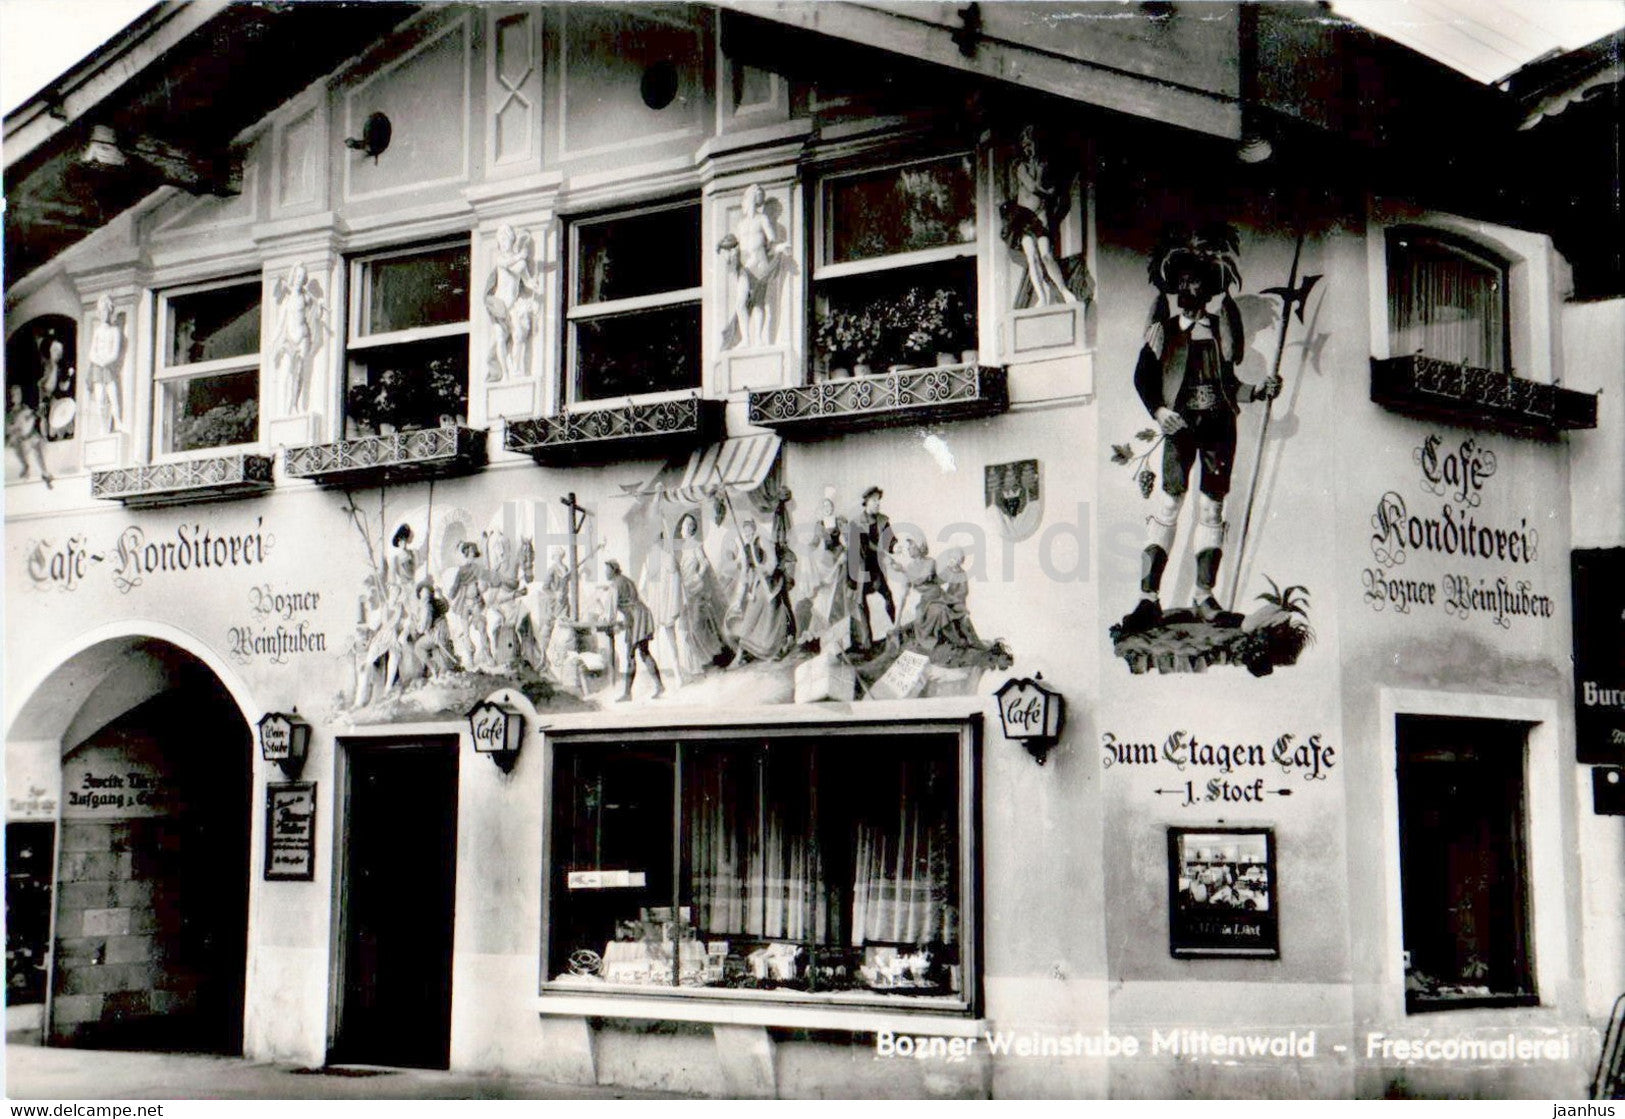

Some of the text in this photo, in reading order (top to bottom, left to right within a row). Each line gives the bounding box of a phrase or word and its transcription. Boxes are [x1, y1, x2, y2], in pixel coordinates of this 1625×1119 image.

[1413, 434, 1497, 508] Café
[1370, 491, 1539, 568] Konditorei
[113, 516, 275, 594] Konditorei
[250, 583, 321, 620] Bozner
[1361, 568, 1437, 614] Bozner
[476, 717, 503, 747] Café
[1007, 696, 1041, 731] Café
[1102, 730, 1336, 781] Zum Etagen Cafe
[1205, 778, 1264, 803] Stock
